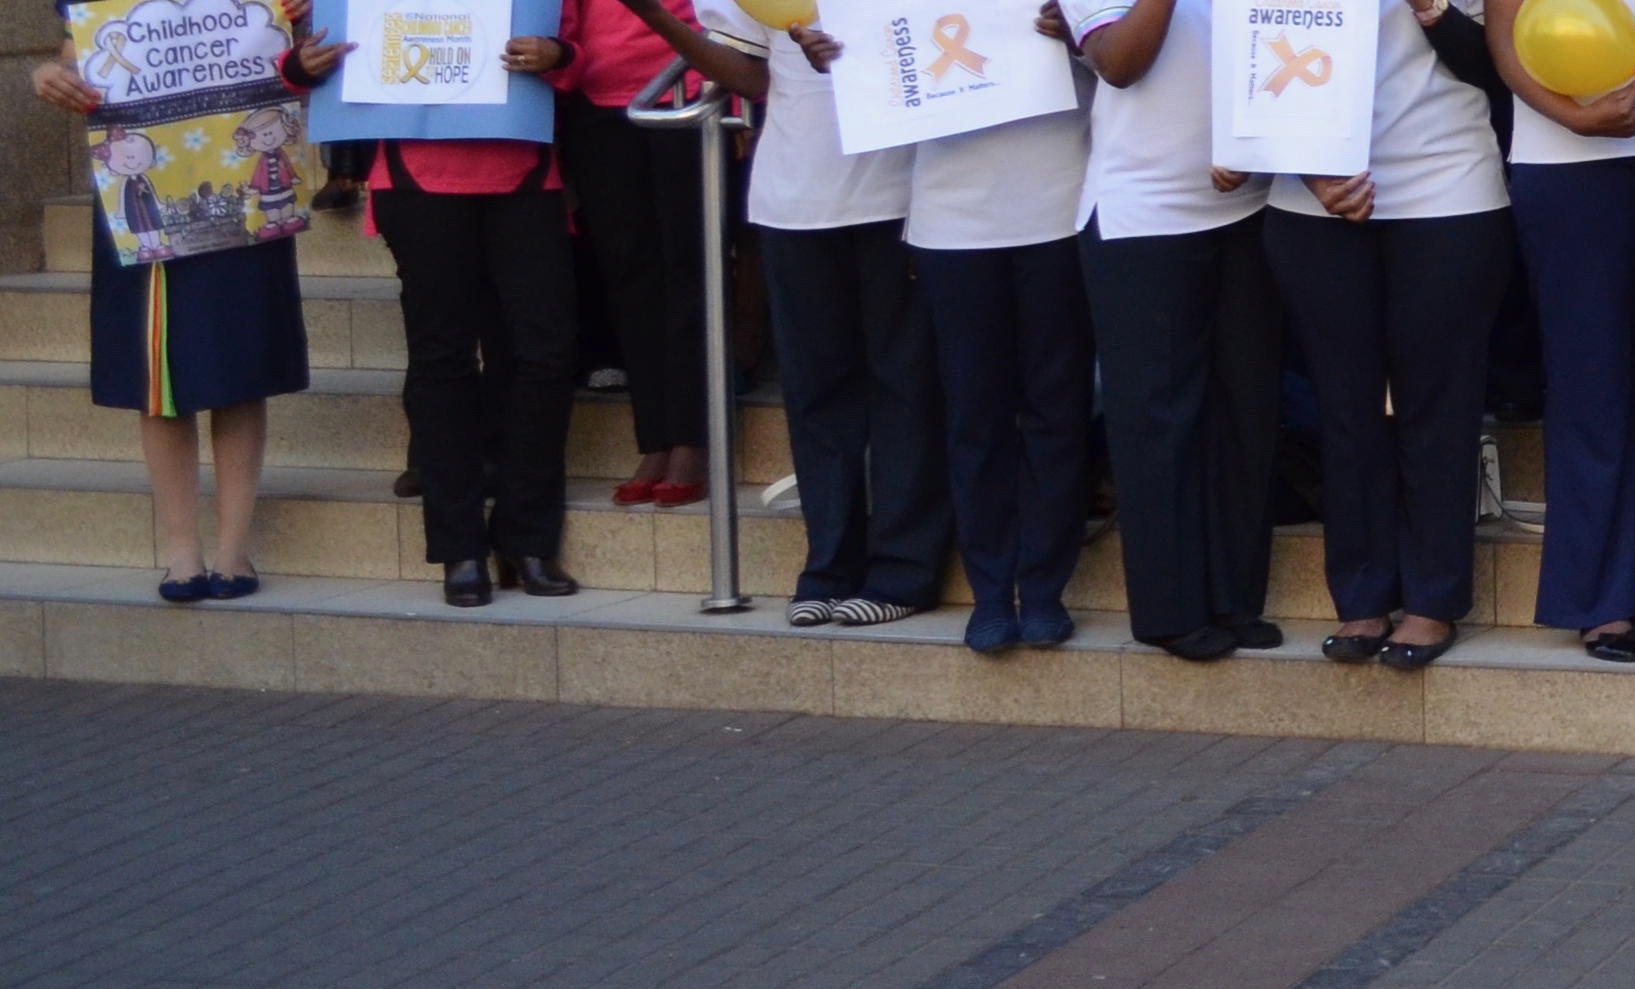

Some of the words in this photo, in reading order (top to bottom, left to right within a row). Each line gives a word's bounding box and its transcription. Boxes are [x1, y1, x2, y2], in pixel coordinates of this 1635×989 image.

[126, 6, 249, 43] Childhood
[1249, 8, 1343, 30] awareness
[429, 47, 453, 65] HOLD
[457, 47, 471, 65] ON
[892, 17, 922, 108] awareness
[126, 55, 266, 97] Awareness
[435, 66, 469, 84] HOPE
